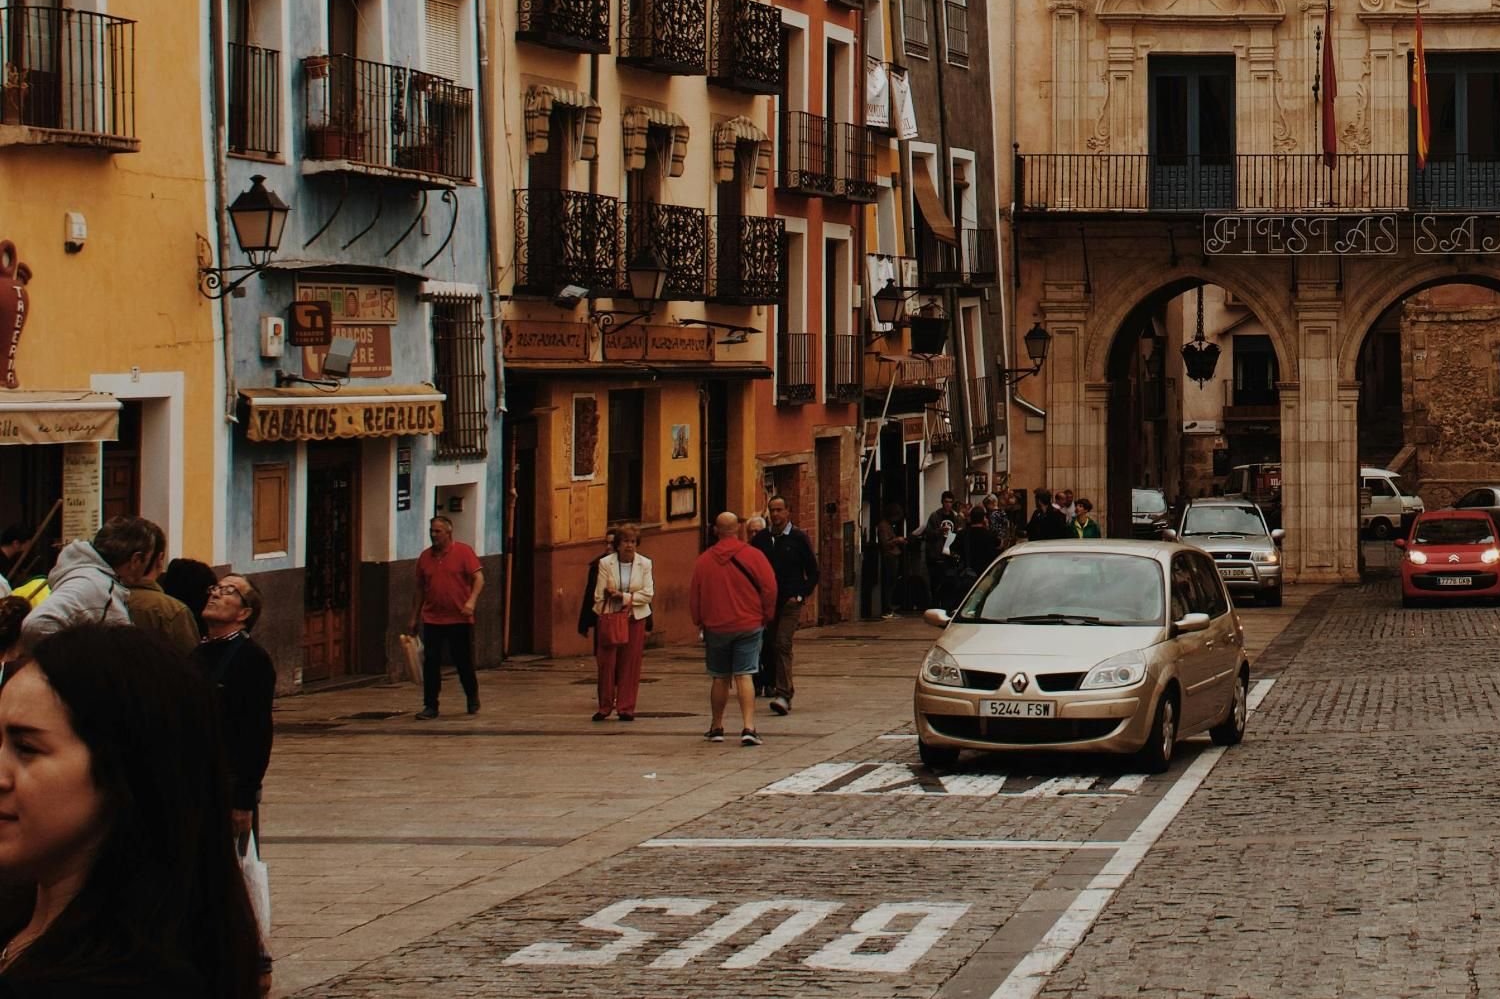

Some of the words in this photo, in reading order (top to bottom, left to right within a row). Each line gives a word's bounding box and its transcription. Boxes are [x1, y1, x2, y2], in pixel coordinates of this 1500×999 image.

[1207, 217, 1394, 253] FIESTAS
[7, 286, 24, 383] TABERNA
[258, 407, 338, 437] TABACOS
[363, 405, 436, 432] REGALOS
[990, 702, 1020, 715] 5244
[1027, 703, 1050, 716] FSW
[501, 897, 973, 973] BUS
